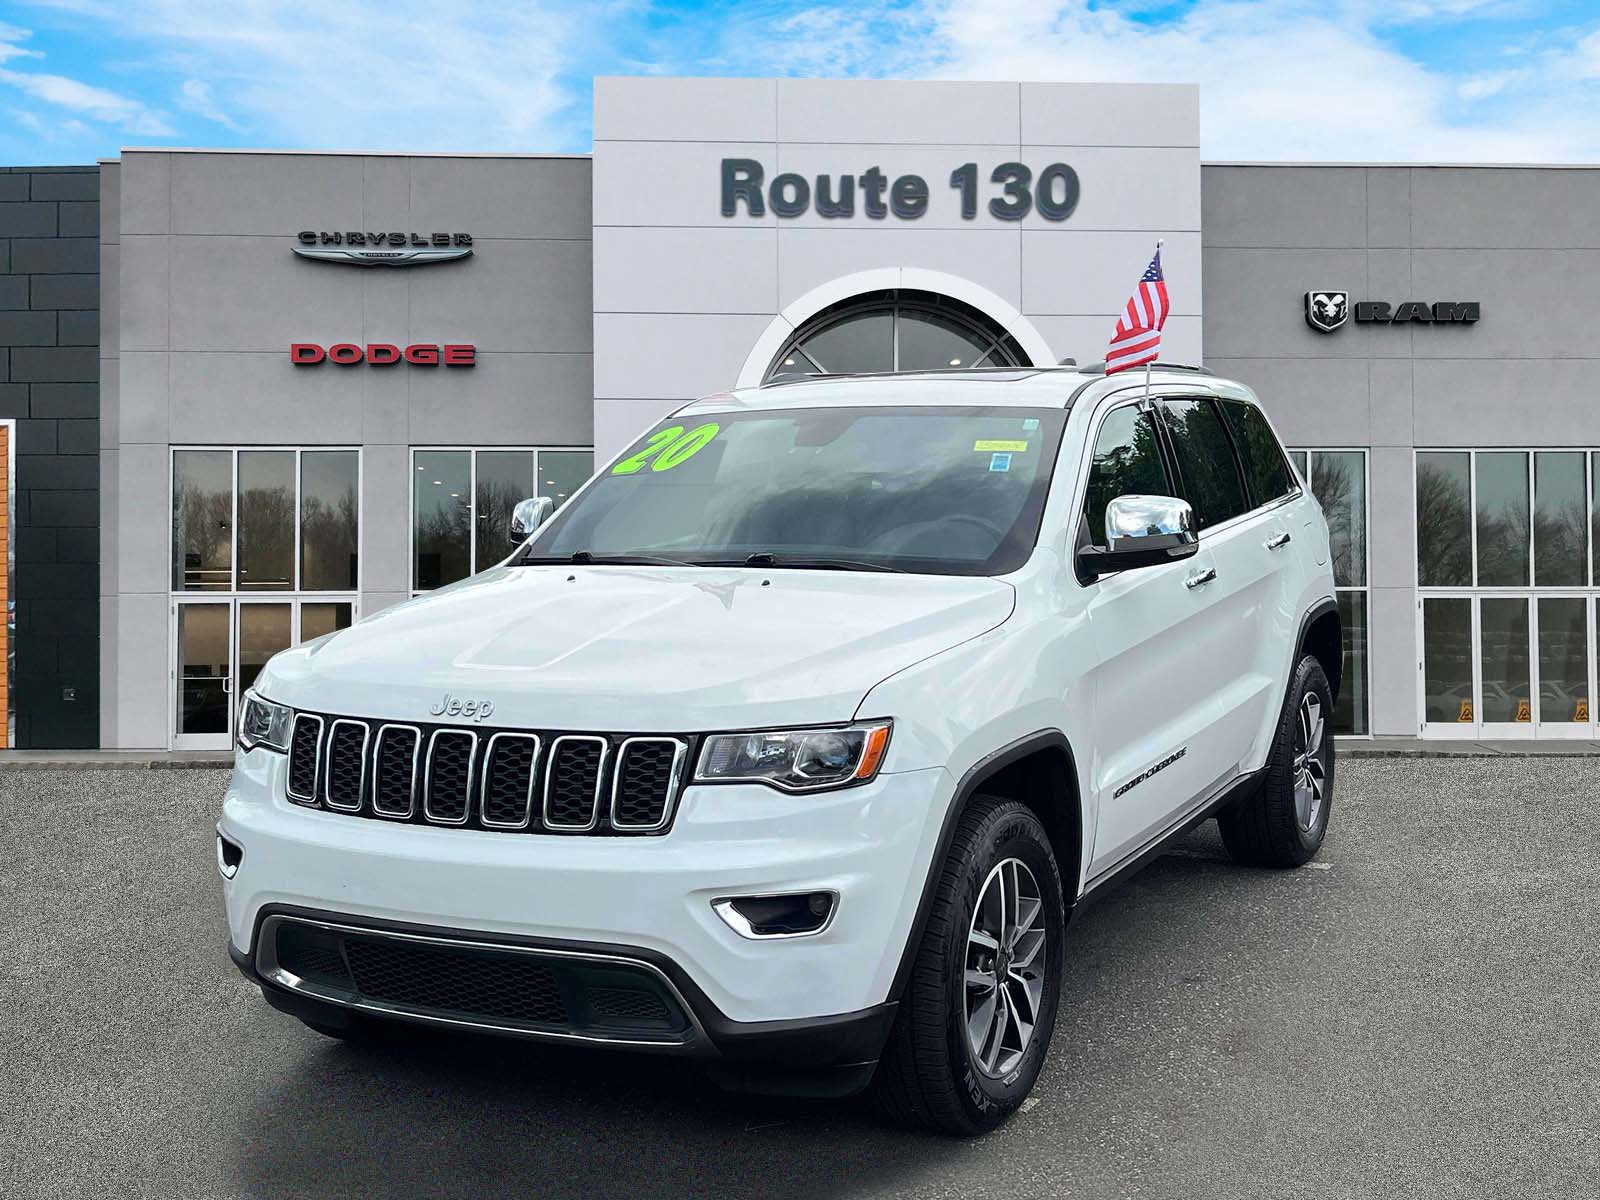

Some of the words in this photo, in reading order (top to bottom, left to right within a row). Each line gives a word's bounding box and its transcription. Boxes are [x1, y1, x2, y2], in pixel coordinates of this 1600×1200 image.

[720, 158, 929, 219] Route
[949, 162, 1081, 221] 130
[298, 231, 473, 246] CHRYSLER
[1355, 302, 1480, 324] RAM
[291, 343, 476, 366] DODGE
[611, 422, 720, 475] 20
[429, 692, 495, 722] Jeep
